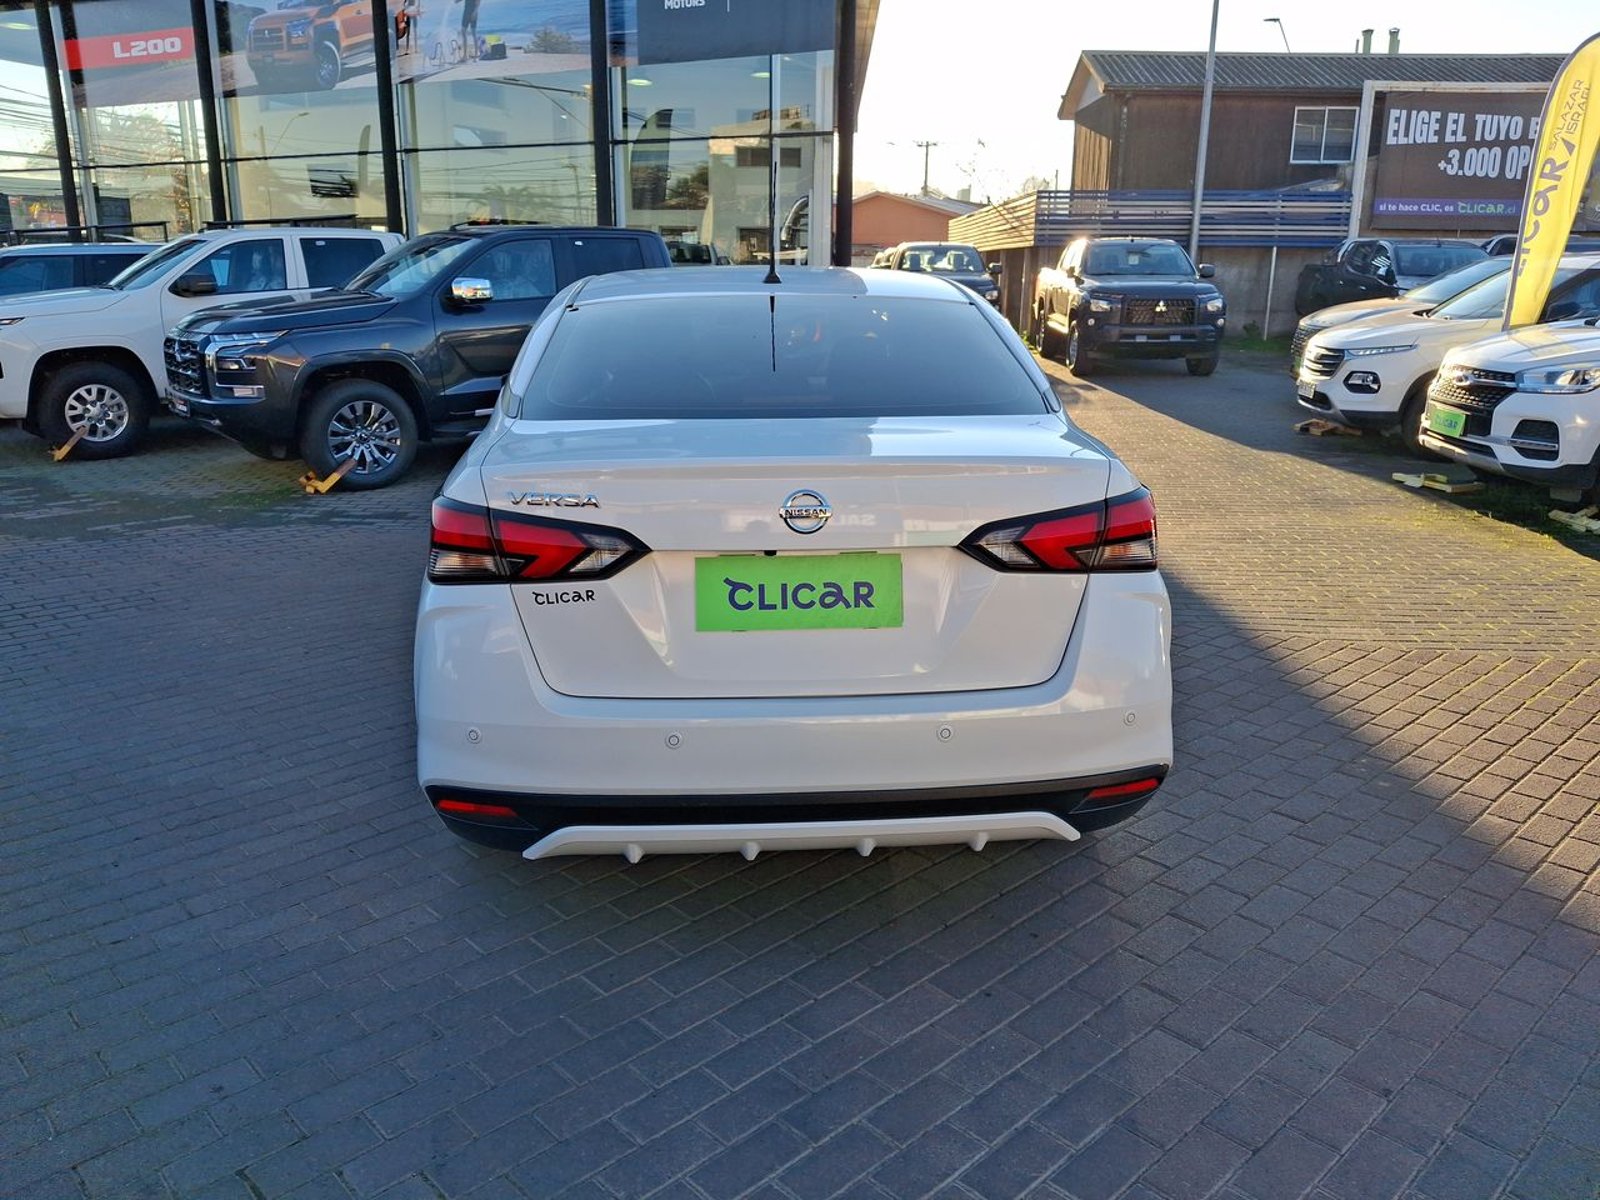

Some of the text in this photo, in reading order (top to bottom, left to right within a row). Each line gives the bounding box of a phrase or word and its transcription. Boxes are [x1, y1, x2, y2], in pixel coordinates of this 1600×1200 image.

[113, 37, 182, 58] L200
[1548, 79, 1585, 152] SALAZAR
[1386, 108, 1441, 145] ELIGE
[1444, 112, 1467, 143] EL
[1474, 114, 1524, 142] TUYO
[1437, 145, 1531, 180] +3.000 OP
[1398, 202, 1418, 212] hace
[1420, 203, 1442, 213] CLIC,
[508, 491, 601, 508] VERSA
[784, 507, 828, 518] NISSAN
